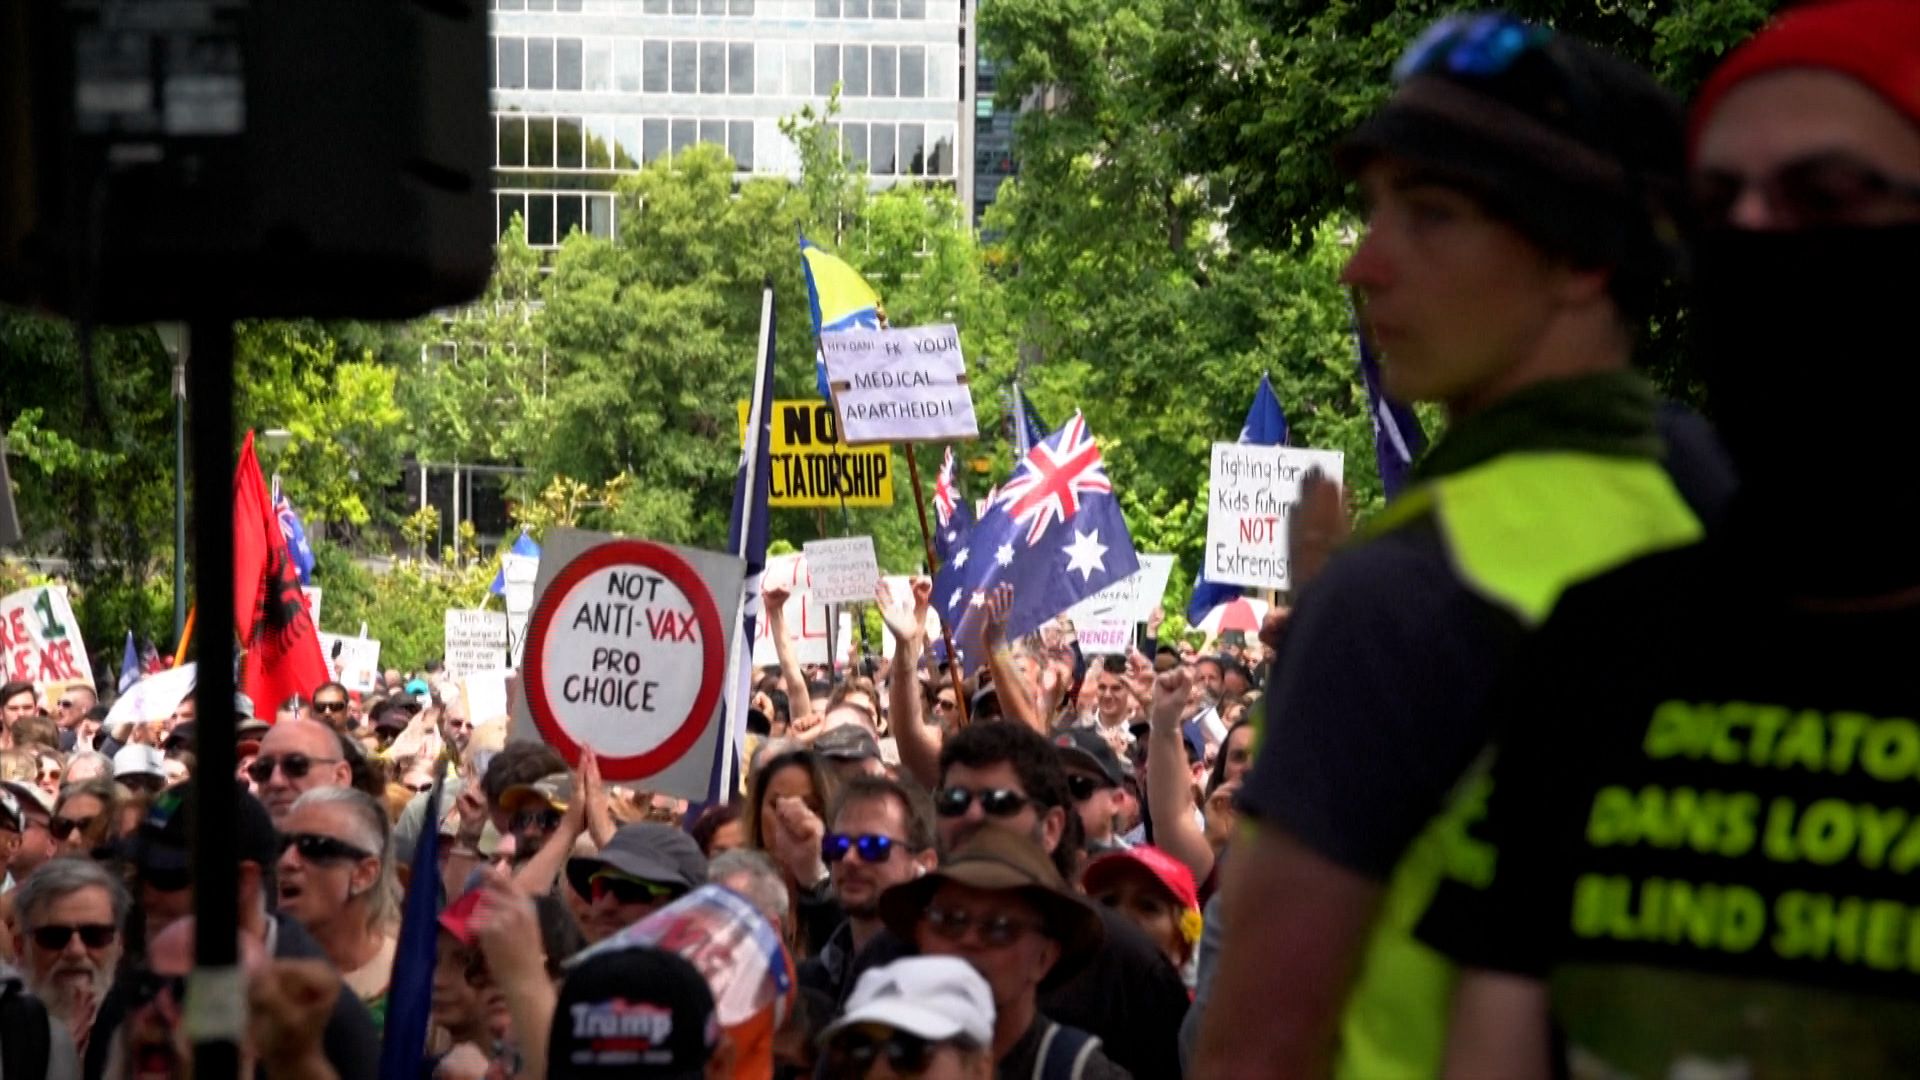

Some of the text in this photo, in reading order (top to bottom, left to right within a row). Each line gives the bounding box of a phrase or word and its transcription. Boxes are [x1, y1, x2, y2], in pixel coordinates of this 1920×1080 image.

[913, 337, 958, 354] YOUR
[854, 370, 936, 389] MEDICAL
[783, 405, 839, 446] NO
[846, 400, 954, 420] APARTHEID!!
[769, 452, 888, 499] CTATORSHIP
[1220, 451, 1272, 488] Fighting
[1218, 487, 1291, 517] Kids futur
[1239, 517, 1281, 544] NOT
[608, 571, 664, 602] NOT
[34, 588, 66, 639] 1
[572, 601, 696, 644] ANTI-VAX
[39, 640, 84, 682] ARE
[592, 647, 641, 676] PRO
[563, 674, 660, 712] CHOICE
[1642, 698, 1920, 783] DICTATO
[1585, 784, 1761, 858] DANS
[1570, 871, 1766, 953] BLIND
[569, 1002, 674, 1047] Trump
